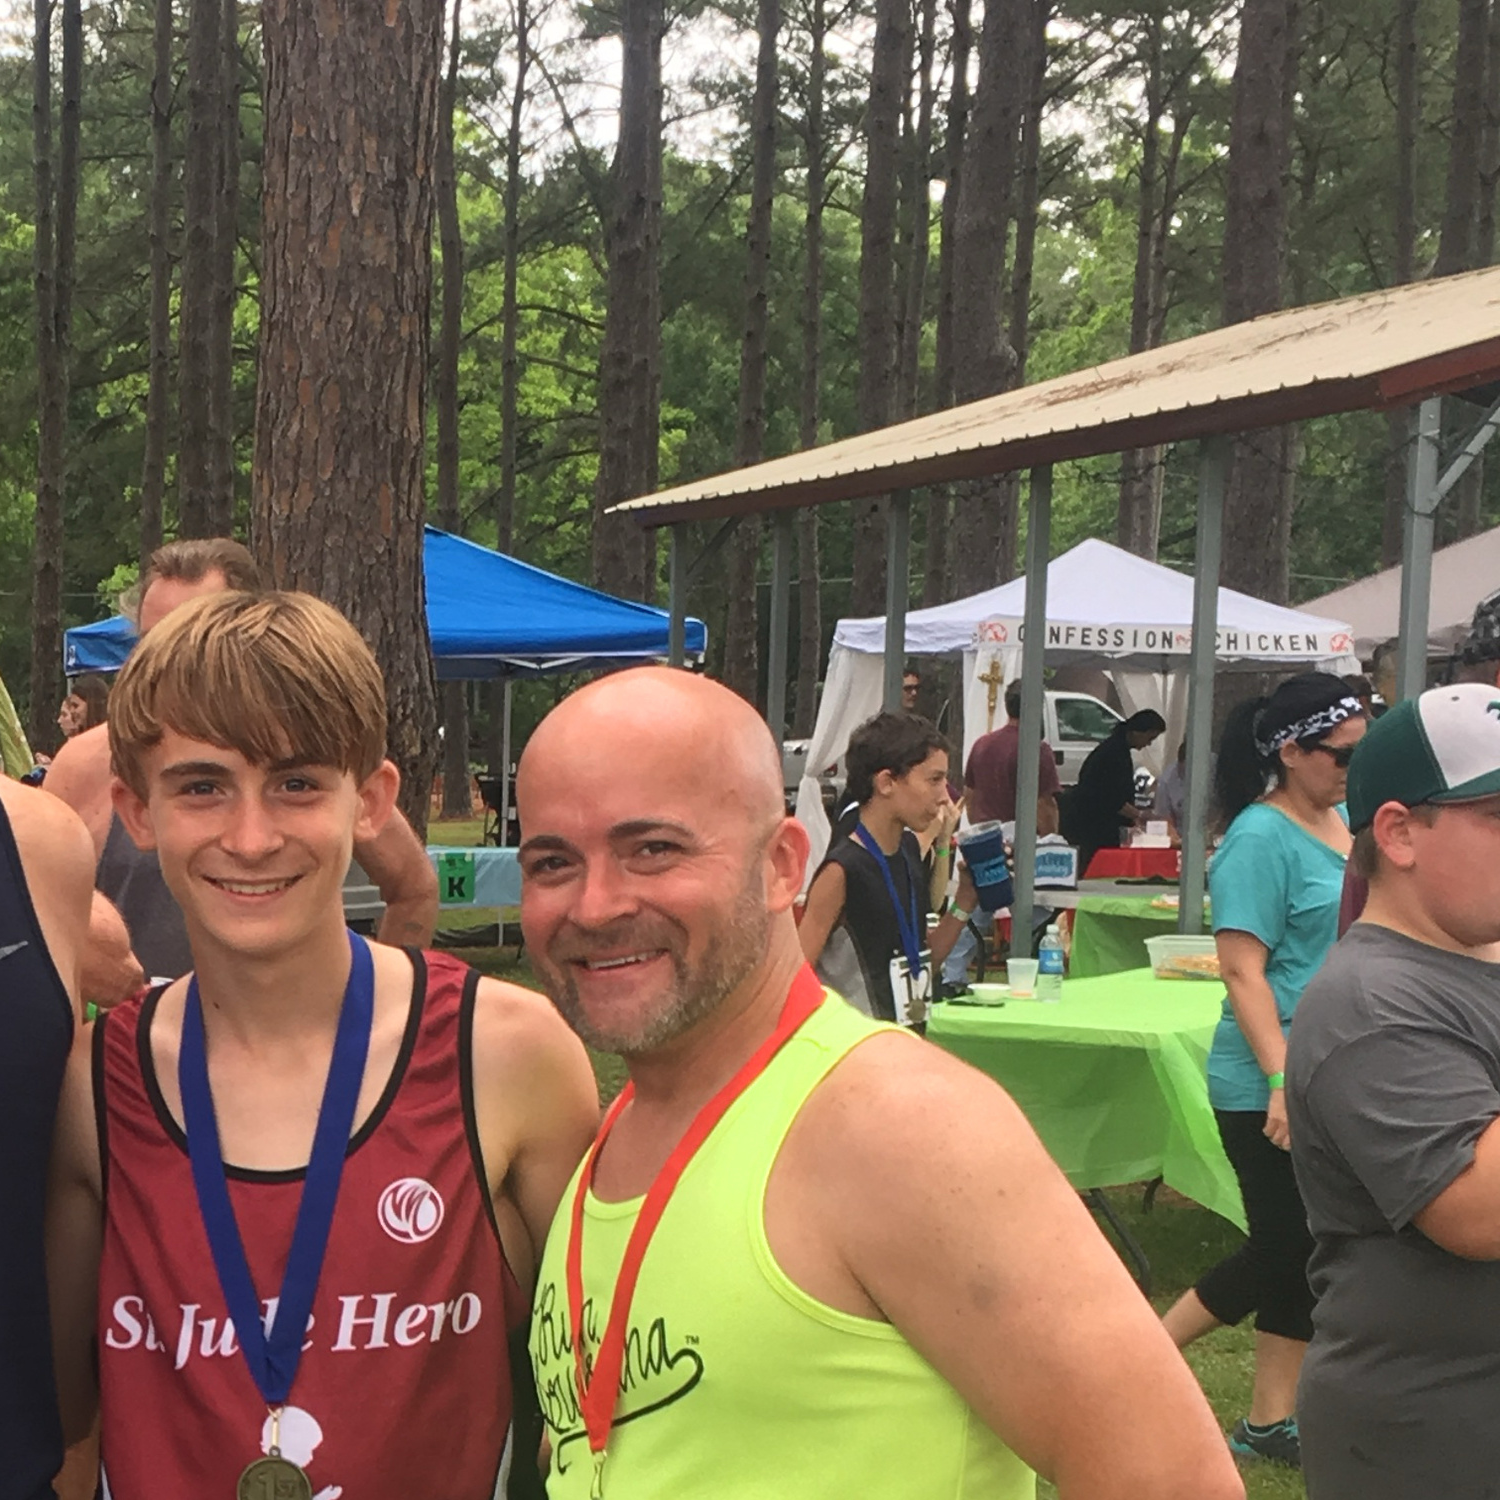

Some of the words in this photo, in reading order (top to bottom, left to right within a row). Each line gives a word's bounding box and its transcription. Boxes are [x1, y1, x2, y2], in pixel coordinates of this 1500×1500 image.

[1018, 624, 1174, 649] CNFESSION
[448, 876, 465, 897] K
[175, 1296, 315, 1370] Ju
[331, 1292, 482, 1352] Hero
